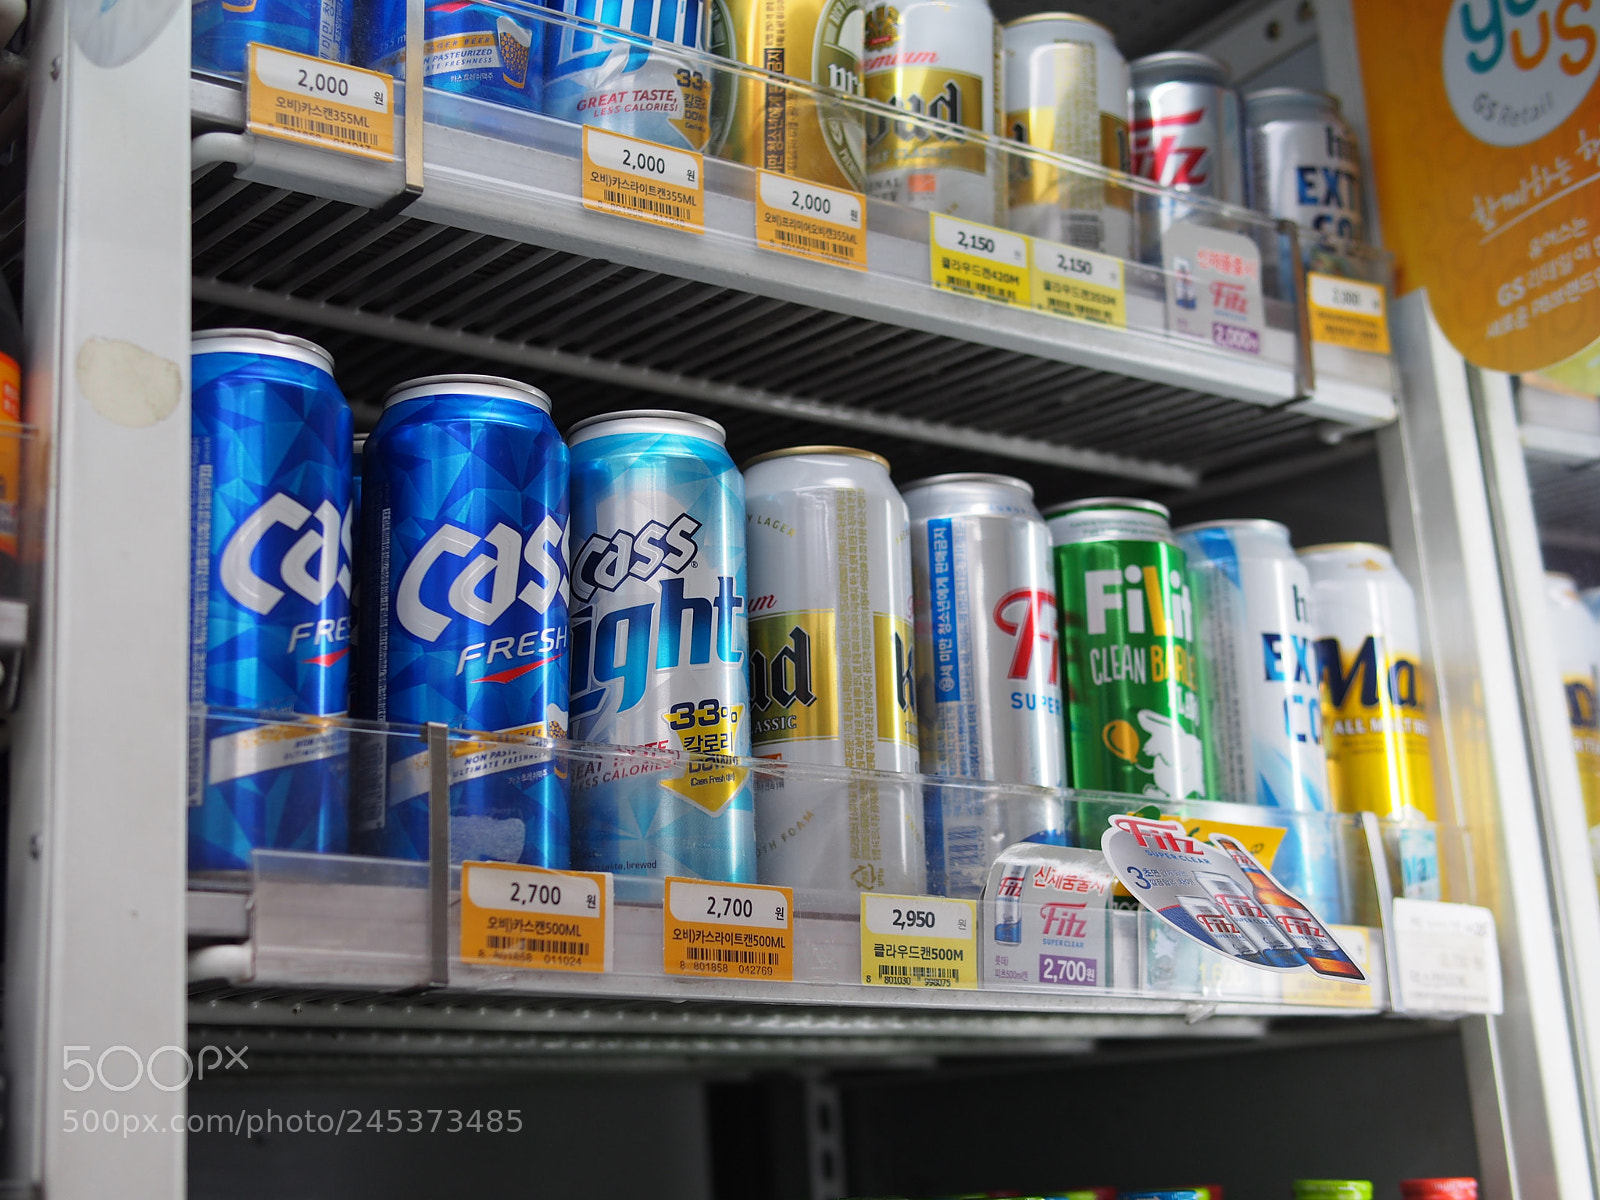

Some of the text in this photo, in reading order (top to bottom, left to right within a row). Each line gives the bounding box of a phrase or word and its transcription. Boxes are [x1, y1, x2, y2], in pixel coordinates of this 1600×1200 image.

[432, 48, 493, 62] PASTEURIZED
[444, 57, 492, 68] FRESHNESS
[298, 69, 384, 106] 2,000 원
[677, 68, 708, 91] 33
[275, 96, 370, 128] 오비)카스캔355ML
[576, 89, 678, 112] GREAT TASTE,
[593, 102, 678, 118] LESS CALORIES!
[622, 149, 696, 182] 2,000 원
[590, 170, 697, 207] 오비)카스라이트캔355ML
[791, 190, 831, 214] 2,000
[957, 230, 995, 253] 2,150
[1057, 253, 1093, 276] 2,150
[1497, 276, 1526, 307] GS
[757, 514, 797, 538] LAGER
[219, 493, 353, 616] Ca
[934, 527, 949, 574] 판매금지
[936, 576, 953, 636] 청소년에게
[287, 619, 351, 653] FRE
[570, 577, 746, 718] ight
[456, 627, 569, 675] FRESH
[938, 639, 954, 662] 미만
[1090, 645, 1146, 686] CLEAN
[1312, 634, 1418, 708] Ma
[670, 699, 738, 731] 33%
[752, 715, 798, 735] ASSIC
[1333, 719, 1367, 736] ALL
[683, 731, 734, 753] 칼로리
[452, 761, 499, 778] ULTIMATE
[1115, 818, 1204, 855] Fitz
[510, 882, 596, 909] 2,700 원
[999, 877, 1025, 897] Fitz
[706, 896, 784, 920] 2,700 원
[1214, 893, 1269, 919] Fitz
[486, 916, 582, 937] 오비)카스캔500ML
[892, 909, 967, 930] 2,950 원
[1040, 902, 1088, 938] Fitz
[1196, 914, 1241, 934] Fitz
[1275, 915, 1325, 938] Fitz
[672, 928, 785, 949] 오비)카스라이트캔500ML
[1042, 938, 1084, 948] SUPER CLEAR
[544, 954, 582, 966] 011024
[874, 943, 964, 961] 클라우드캔500M
[680, 960, 773, 976] 8 801858 042769
[1043, 958, 1096, 982] 2,700원
[866, 975, 872, 984] 8
[884, 975, 912, 985] 801030
